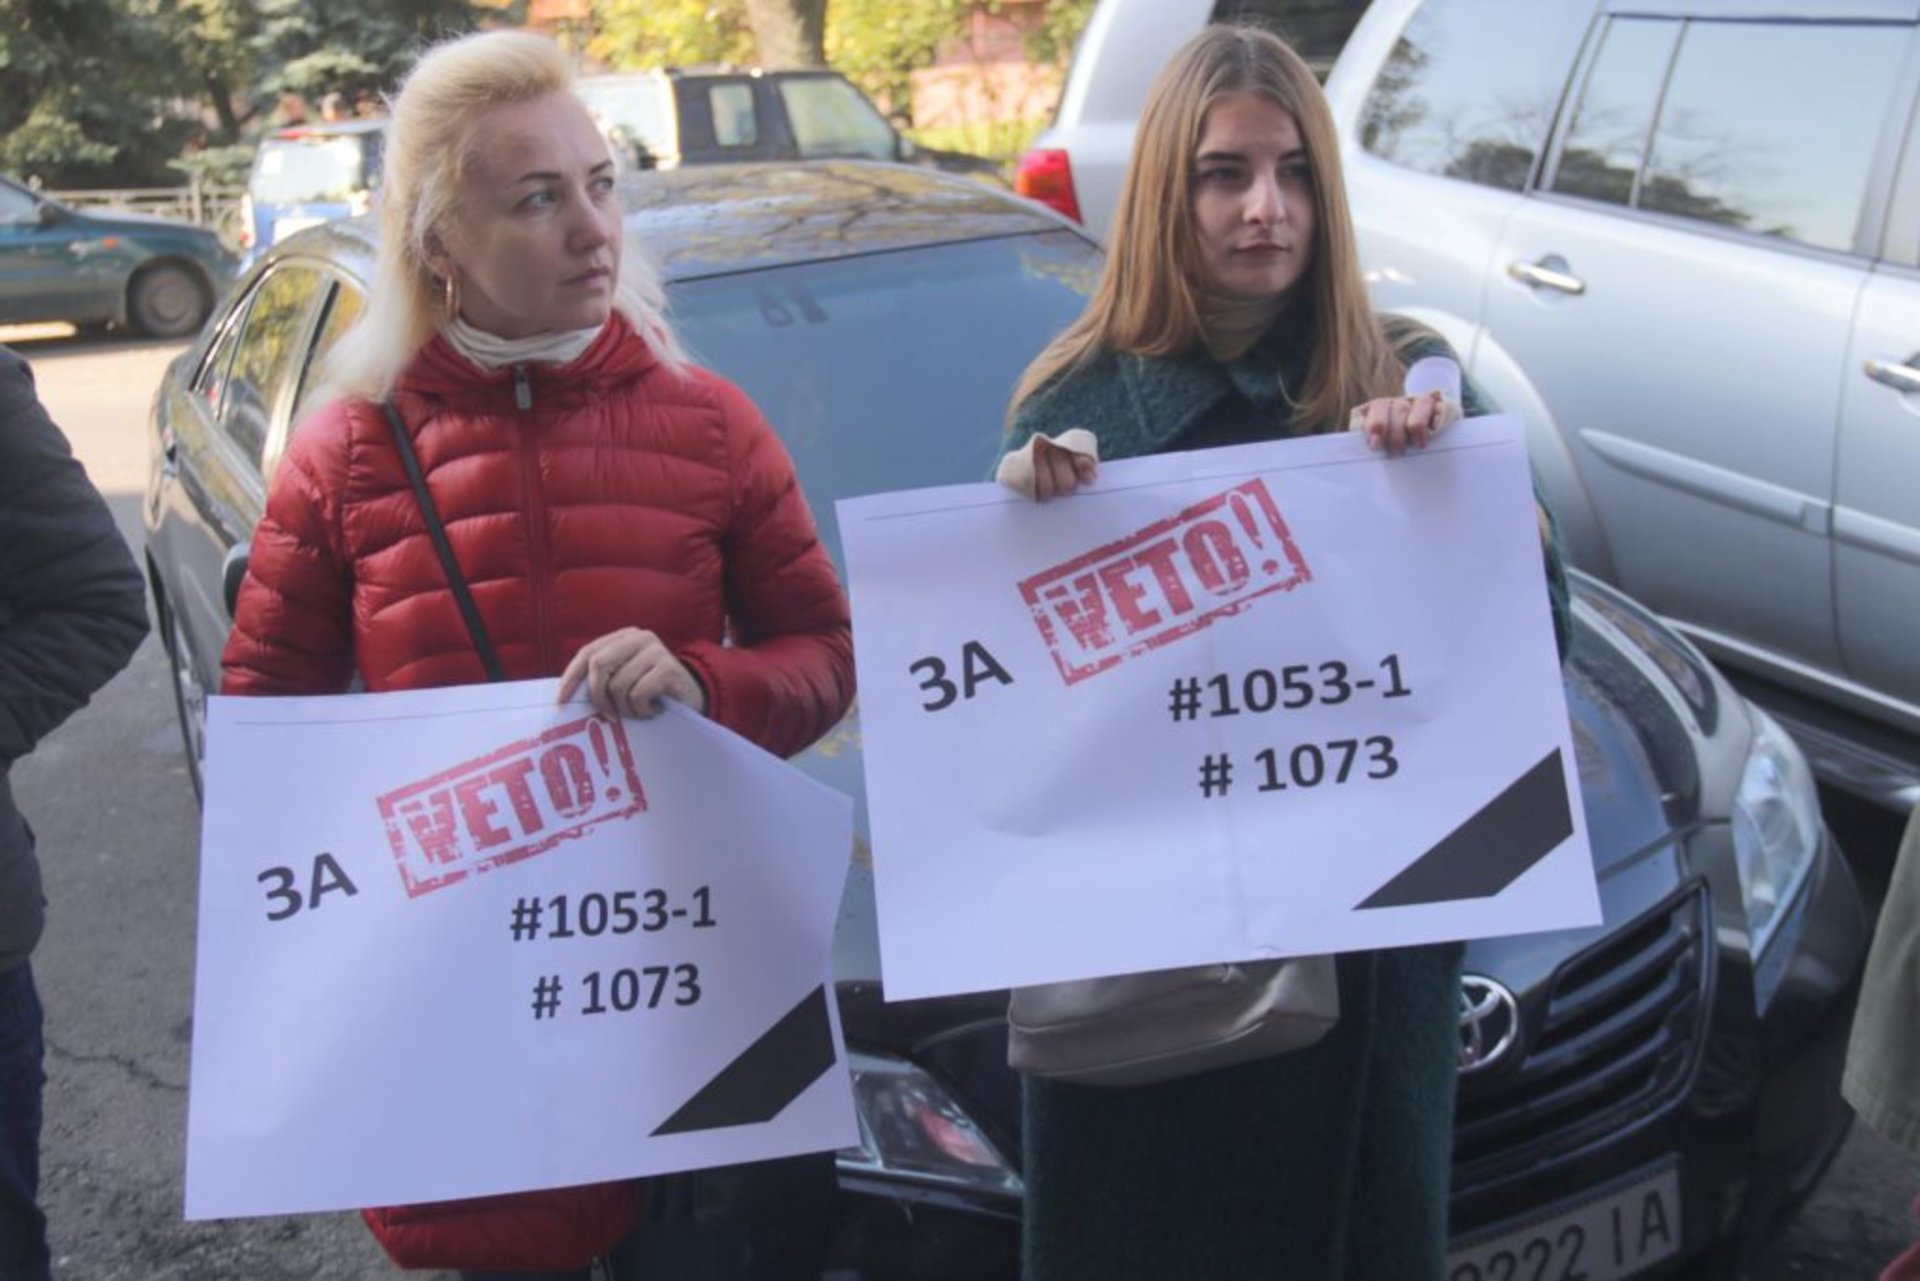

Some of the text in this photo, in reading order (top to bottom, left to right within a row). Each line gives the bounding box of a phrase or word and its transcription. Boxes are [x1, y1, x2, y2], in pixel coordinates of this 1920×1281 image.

[909, 492, 1280, 711] ЗА VETO!
[1168, 654, 1412, 722] #1053-1
[1199, 735, 1399, 798] # 1073
[258, 719, 622, 921] ЗА VETO!
[510, 886, 717, 942] #1053-1
[531, 962, 702, 1020] # 1073
[1611, 1188, 1671, 1267] IA
